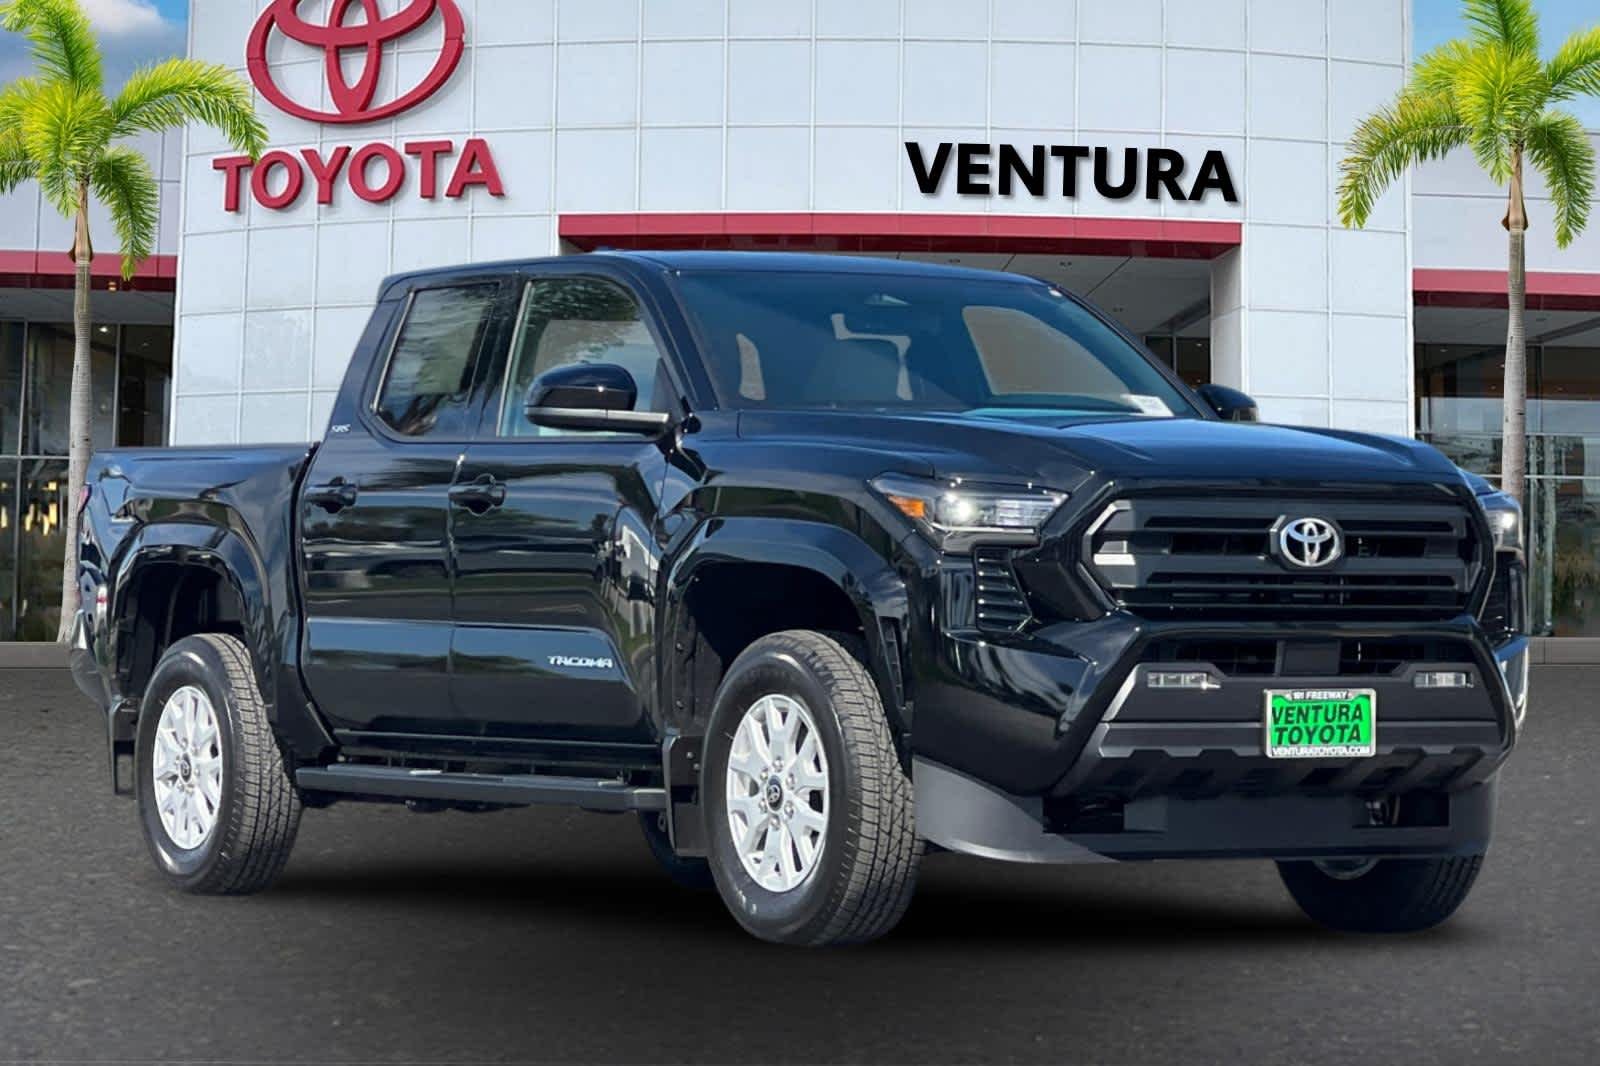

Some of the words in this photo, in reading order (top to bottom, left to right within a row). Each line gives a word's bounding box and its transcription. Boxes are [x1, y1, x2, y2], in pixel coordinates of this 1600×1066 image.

[213, 139, 504, 212] TOYOTA
[905, 142, 1238, 202] VENTURA
[547, 655, 613, 668] TACOMA
[1306, 691, 1347, 700] FREEWAY
[1272, 704, 1363, 725] VENTURA
[1275, 725, 1361, 745] TOYOTA
